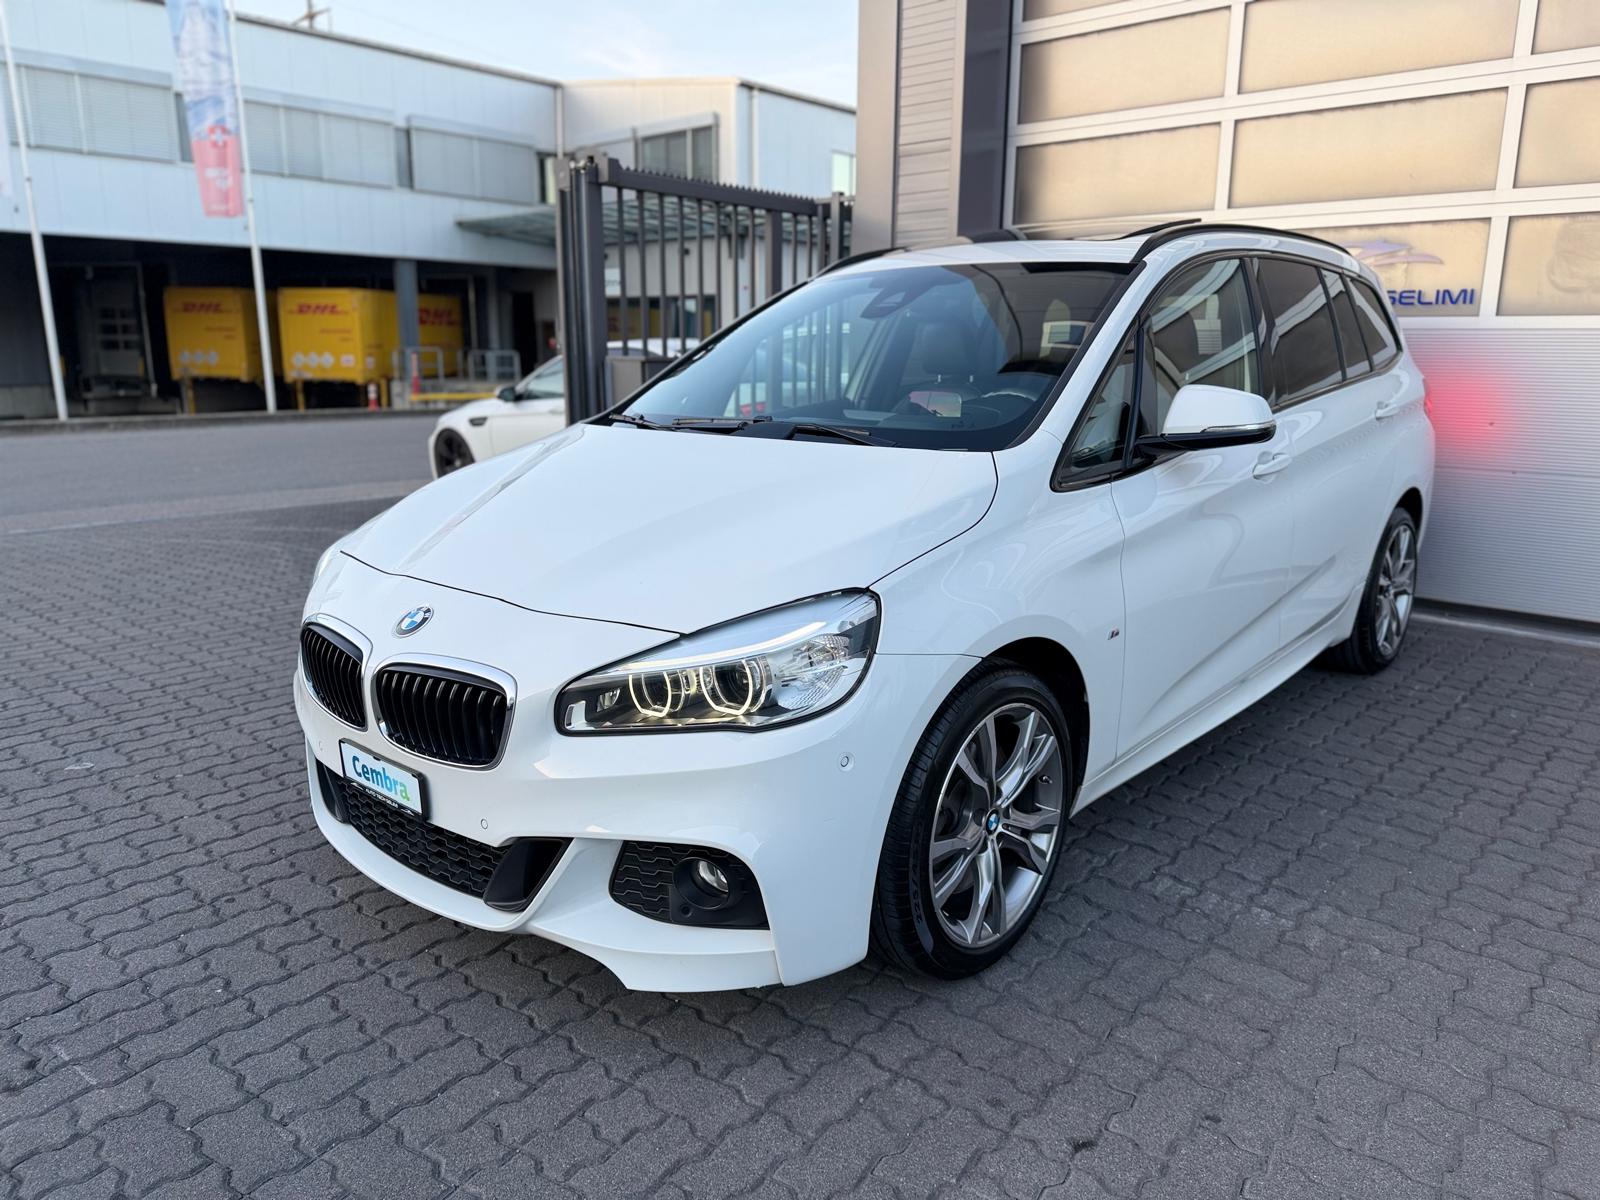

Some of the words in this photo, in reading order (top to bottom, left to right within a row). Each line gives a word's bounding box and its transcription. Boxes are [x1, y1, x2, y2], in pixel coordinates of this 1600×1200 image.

[297, 303, 339, 315] DHL
[418, 308, 458, 325] DHL
[352, 755, 410, 801] Cembra
